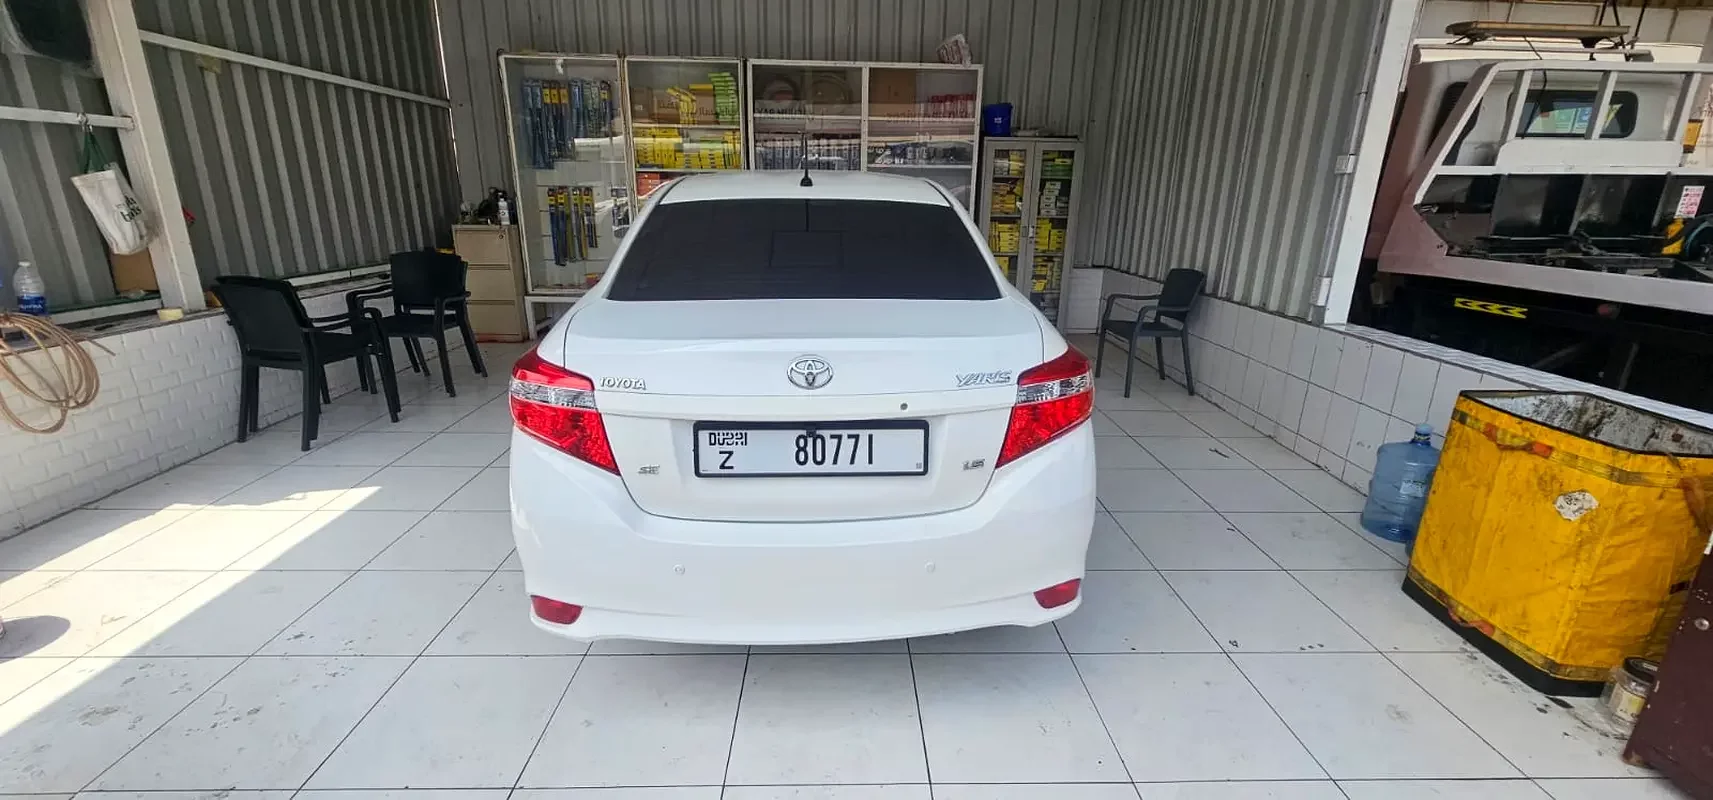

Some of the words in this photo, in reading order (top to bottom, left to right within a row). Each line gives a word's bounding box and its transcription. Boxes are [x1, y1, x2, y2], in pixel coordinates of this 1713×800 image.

[599, 377, 647, 390] TOYOTA
[953, 370, 1012, 388] YARIS
[794, 433, 874, 466] 80771
[718, 450, 735, 470] Z
